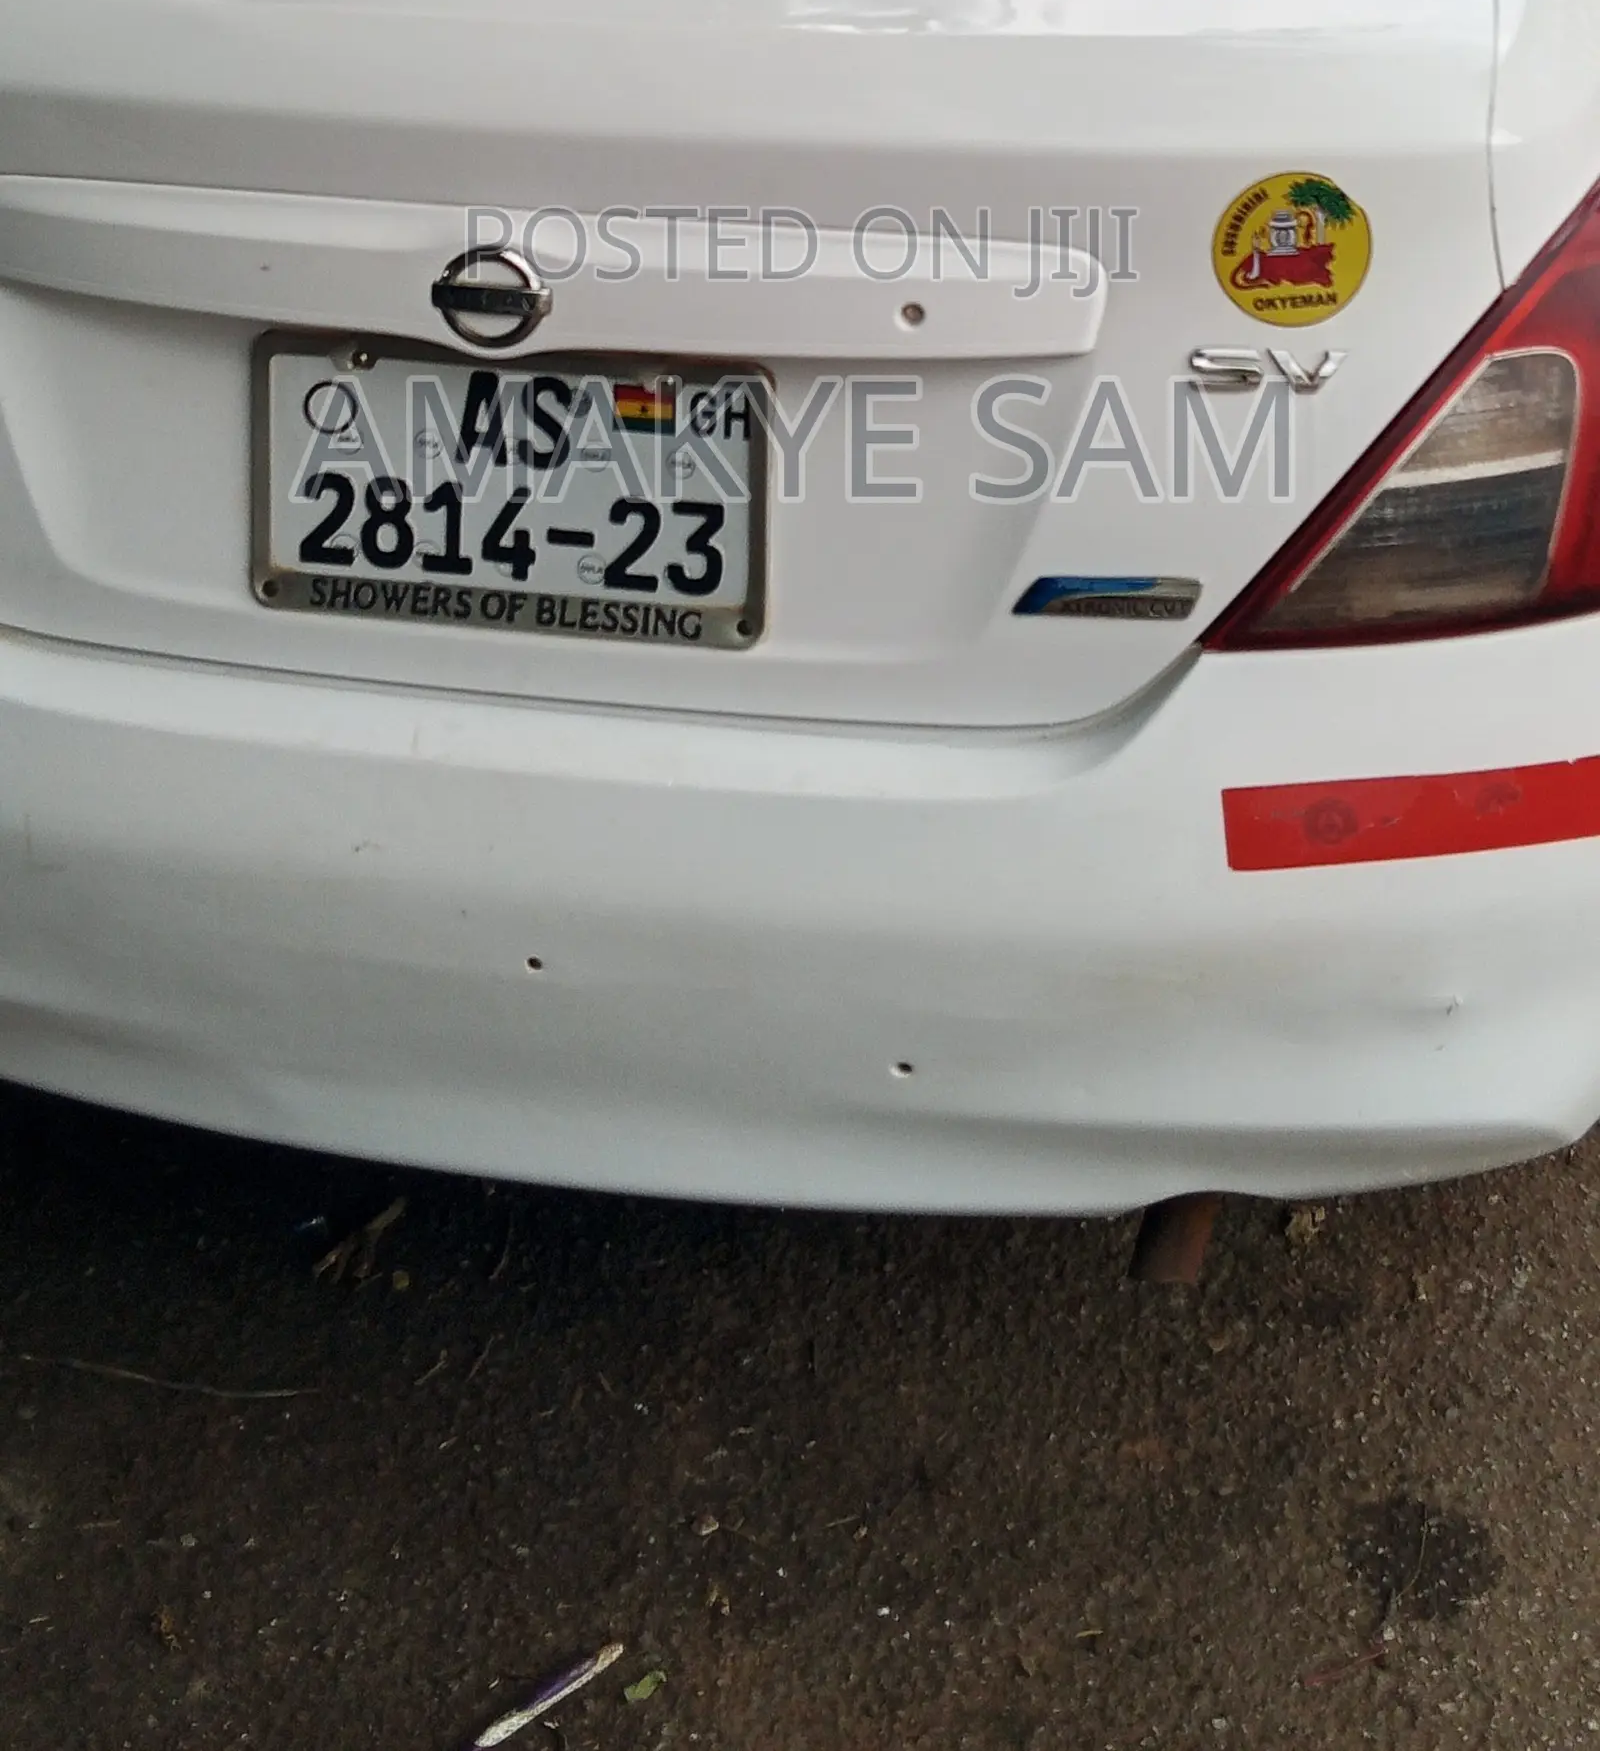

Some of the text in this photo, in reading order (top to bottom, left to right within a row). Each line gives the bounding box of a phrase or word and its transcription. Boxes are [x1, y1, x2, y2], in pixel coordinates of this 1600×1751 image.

[1253, 291, 1338, 311] OKYEMAN
[1188, 347, 1348, 395] SV
[455, 370, 752, 470] AS GH
[299, 472, 725, 597] 2814-23
[309, 578, 702, 639] SHOWERS OF BLESSING
